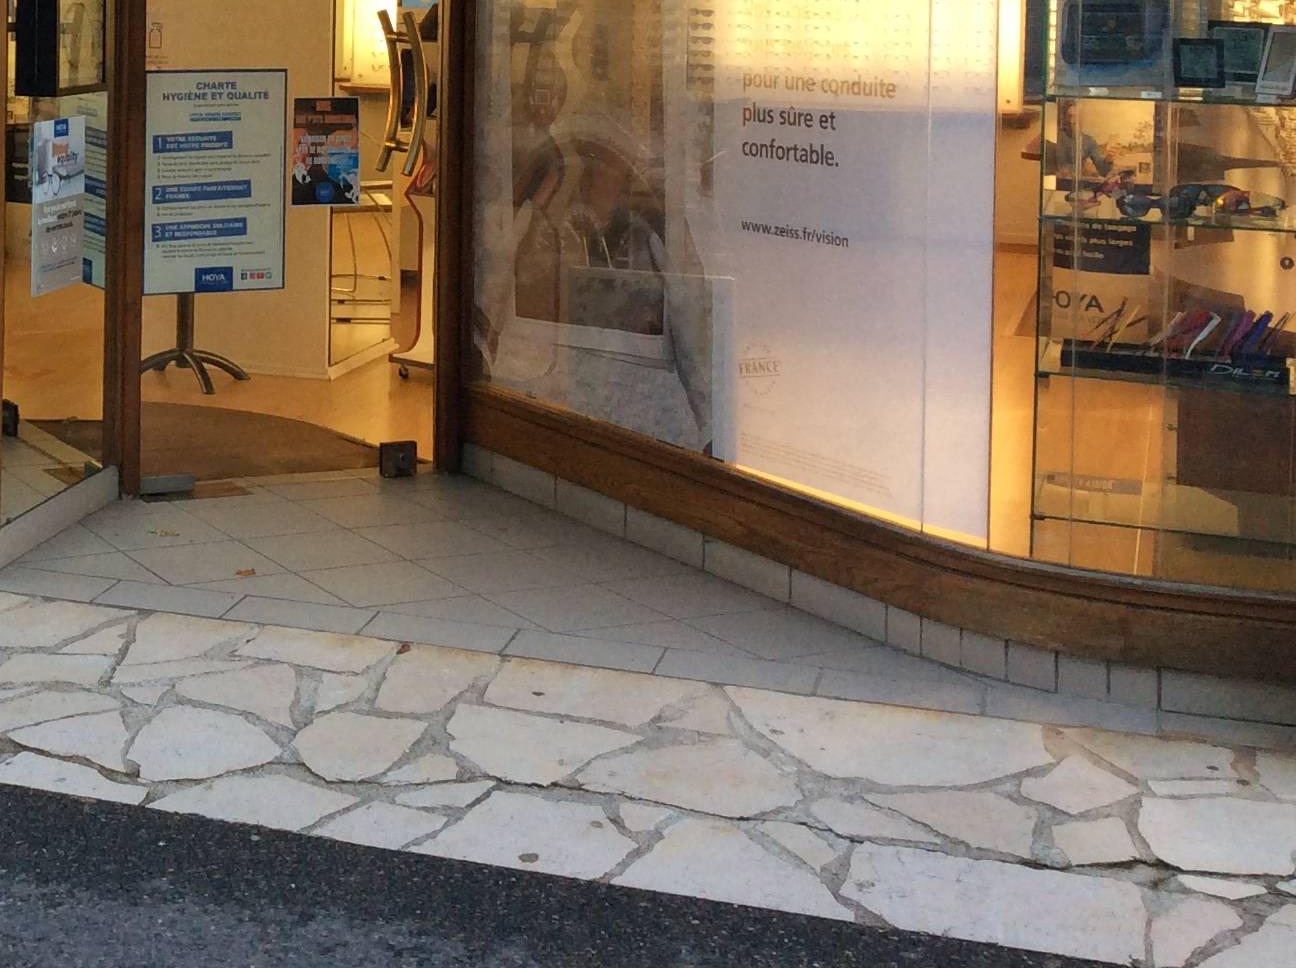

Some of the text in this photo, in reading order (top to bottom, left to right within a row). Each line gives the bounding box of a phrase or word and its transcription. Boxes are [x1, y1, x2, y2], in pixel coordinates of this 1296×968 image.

[196, 81, 237, 90] CHARTE
[742, 70, 897, 99] pour une conduite
[211, 92, 223, 100] ET
[742, 102, 837, 130] plus sûre et
[742, 139, 840, 167] confortable.
[155, 188, 163, 201] 2
[154, 226, 162, 238] 3
[741, 219, 850, 249] www.zeiss.fr/vision
[738, 359, 780, 375] FRANCE
